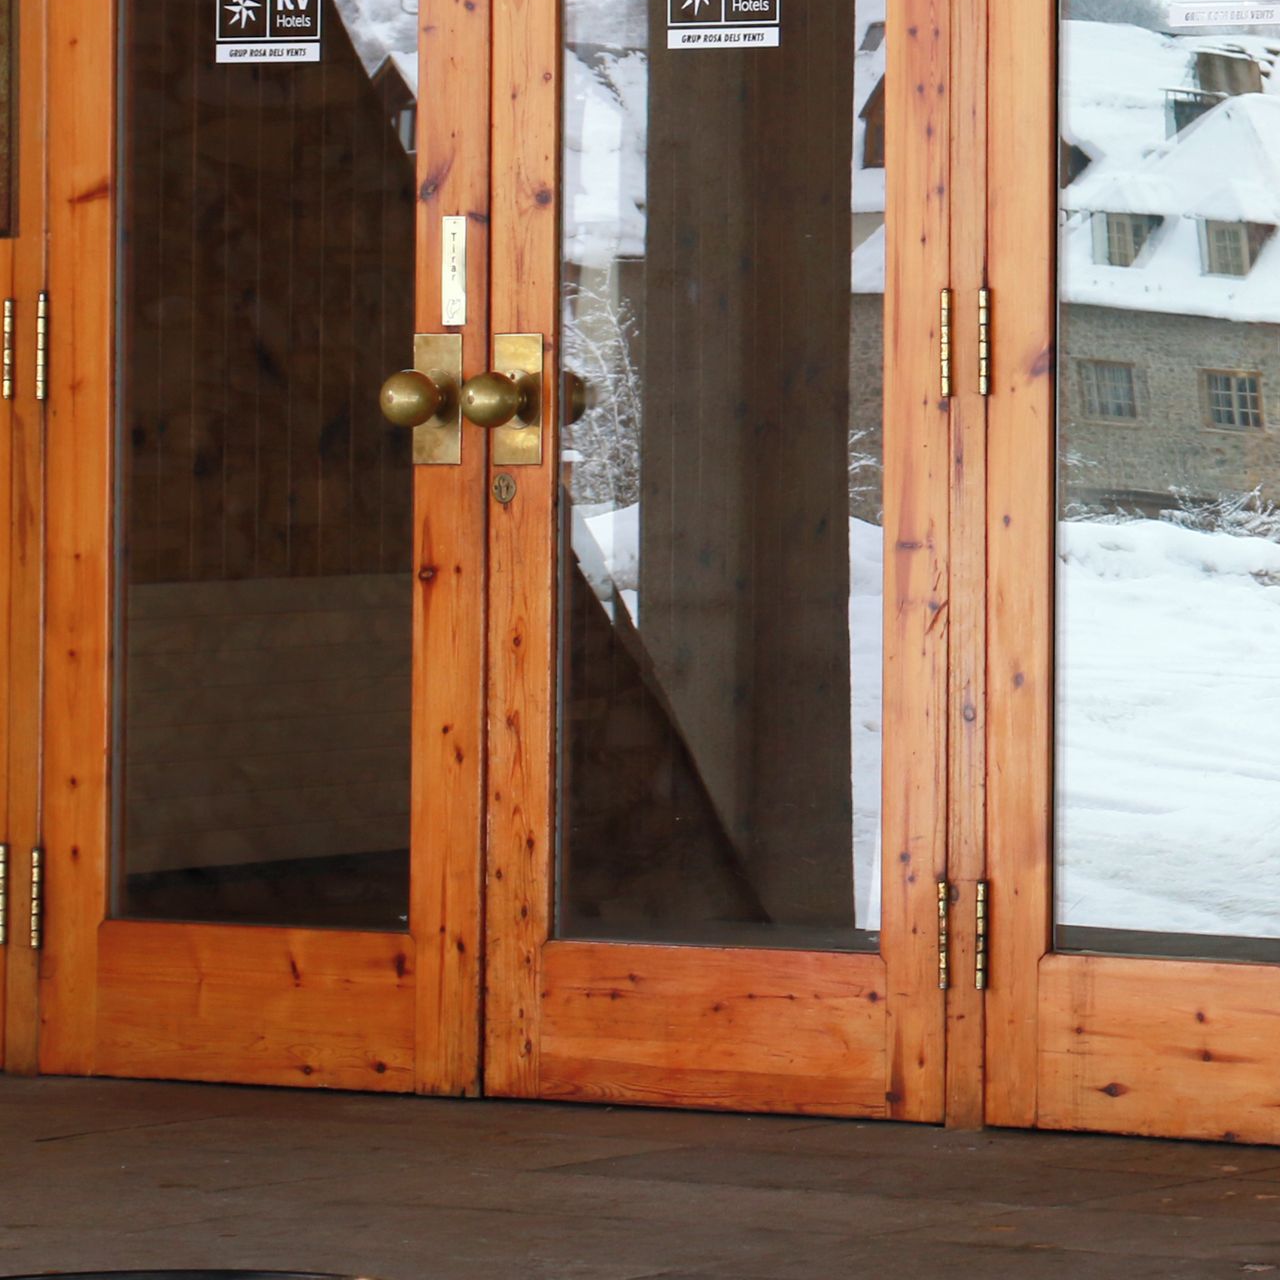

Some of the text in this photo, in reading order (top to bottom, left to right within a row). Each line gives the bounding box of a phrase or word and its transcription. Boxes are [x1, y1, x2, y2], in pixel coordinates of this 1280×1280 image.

[276, 14, 311, 28] Hotels
[681, 32, 765, 43] GRUP ROSA DELS VENTS
[229, 48, 307, 58] GRUP ROSA DELS VENTS
